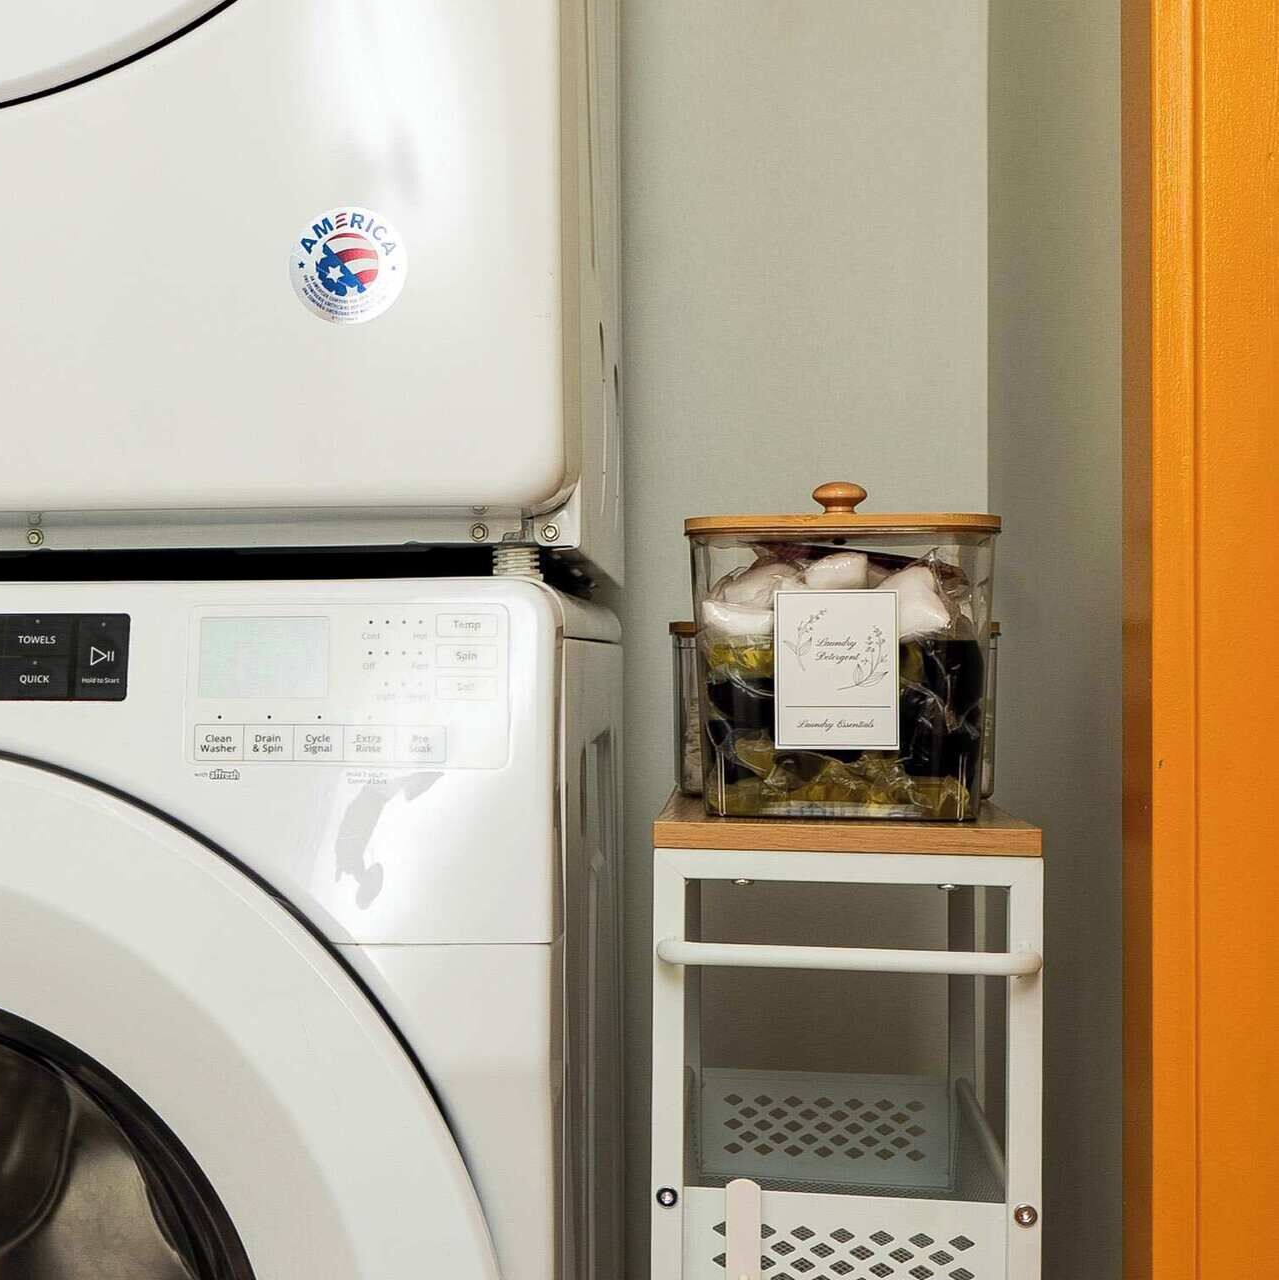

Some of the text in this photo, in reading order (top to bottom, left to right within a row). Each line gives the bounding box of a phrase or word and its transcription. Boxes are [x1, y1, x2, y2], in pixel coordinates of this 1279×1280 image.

[300, 212, 397, 256] AMERICA
[453, 620, 481, 631] Temp
[18, 635, 57, 645] TOWELS
[456, 651, 478, 662] Spin
[19, 675, 50, 685] QUICK
[797, 718, 834, 732] Laundry
[205, 734, 232, 743] Clean
[254, 734, 281, 743] Drain
[305, 734, 331, 744] Cycle
[200, 744, 236, 753] Washer
[252, 744, 283, 754] & Spin
[303, 744, 332, 755] Signal
[356, 744, 382, 753] Rinse
